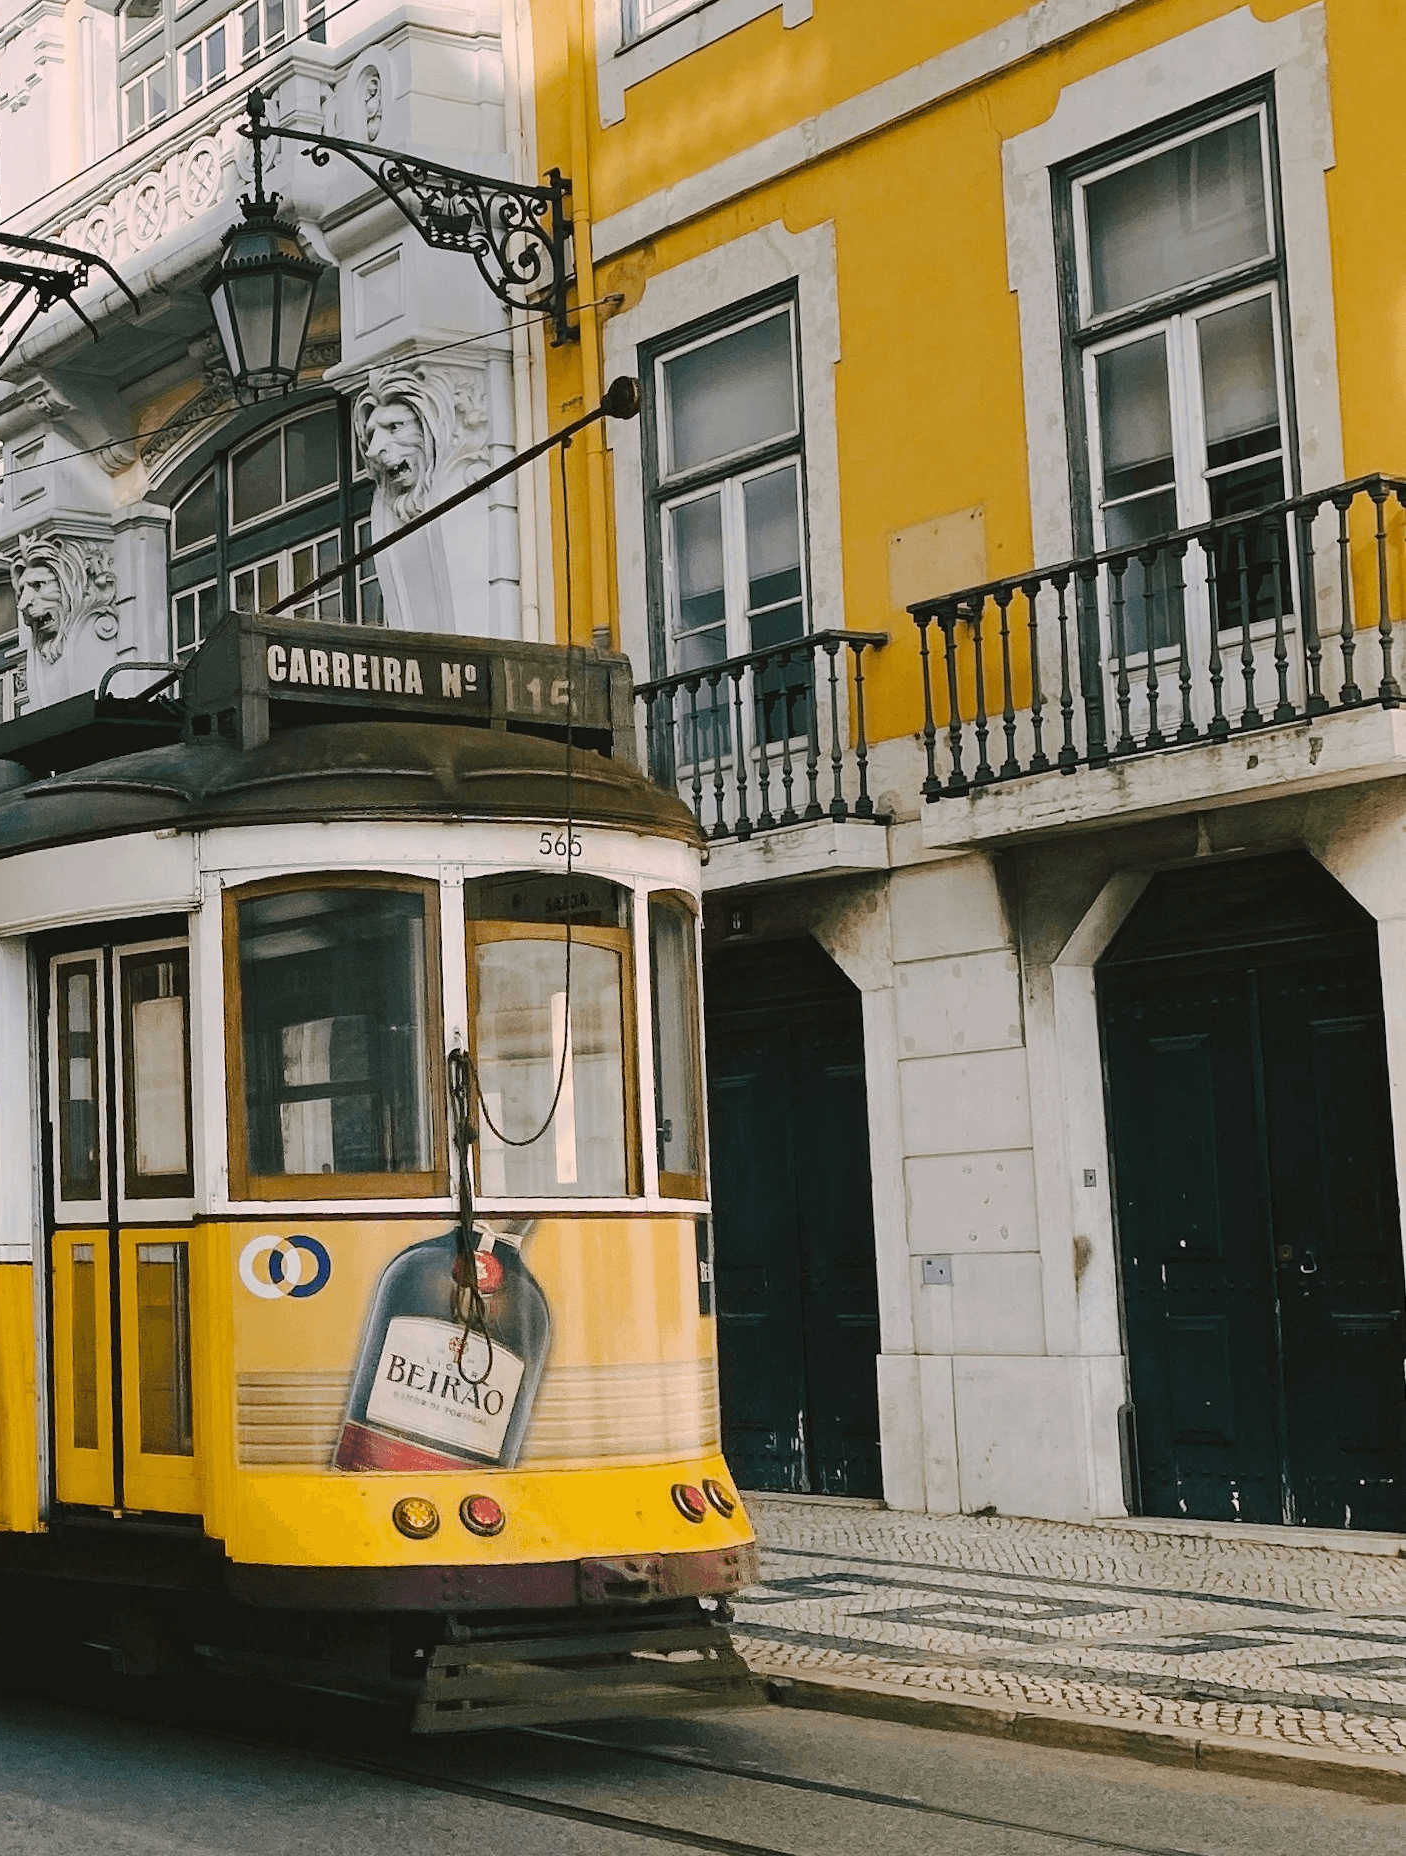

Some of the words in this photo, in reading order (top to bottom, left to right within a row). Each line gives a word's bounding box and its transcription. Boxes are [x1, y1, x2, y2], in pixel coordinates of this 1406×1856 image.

[267, 644, 424, 696] CARREIRA
[526, 677, 578, 716] 15
[539, 832, 582, 857] 565
